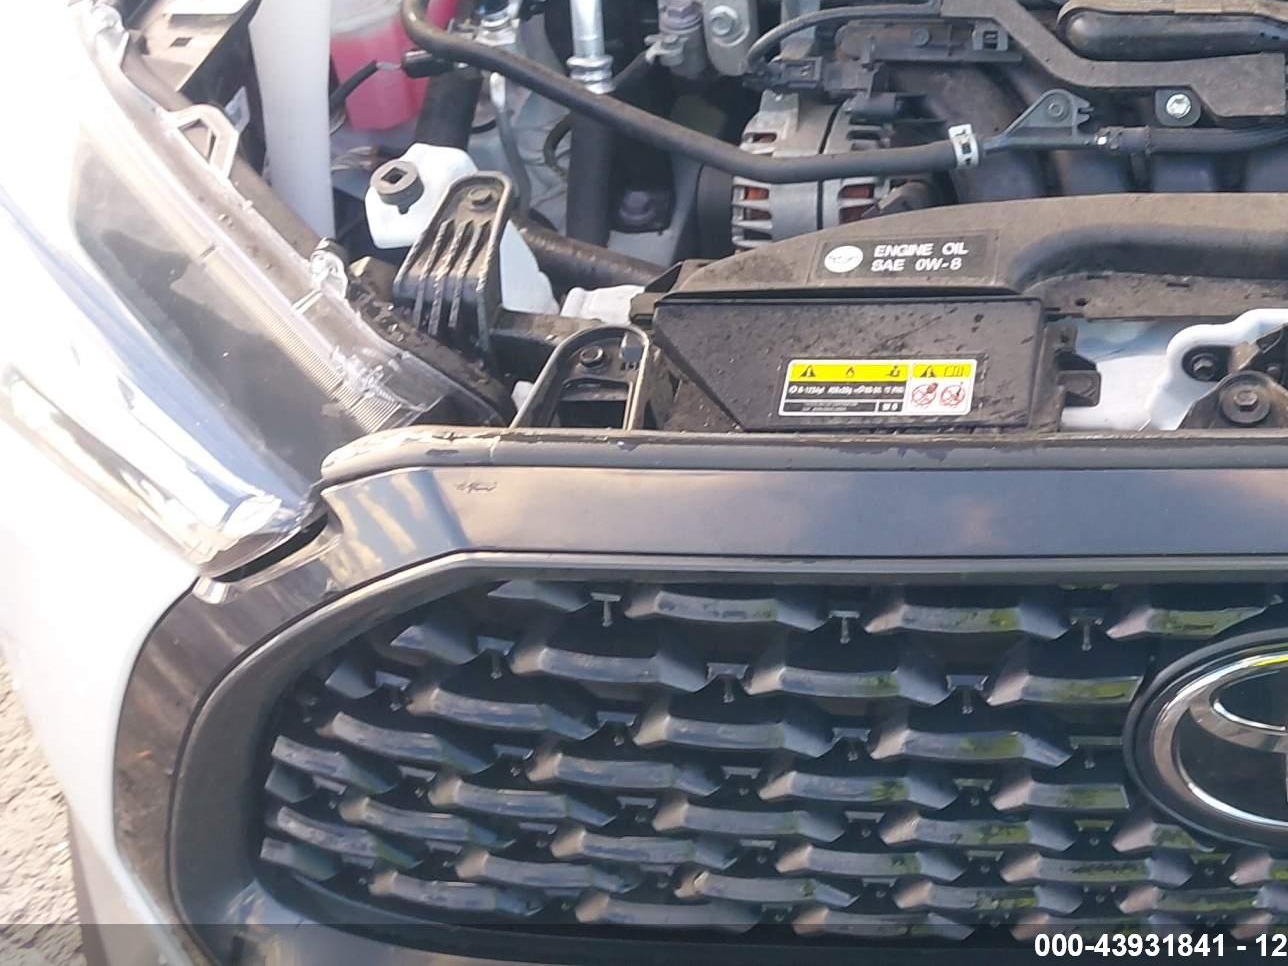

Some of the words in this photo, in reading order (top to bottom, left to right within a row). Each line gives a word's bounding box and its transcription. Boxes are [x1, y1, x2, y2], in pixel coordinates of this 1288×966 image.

[873, 243, 934, 258] ENGINE
[942, 242, 969, 255] OIL
[871, 259, 905, 272] SAE
[915, 257, 962, 272] 0W-8
